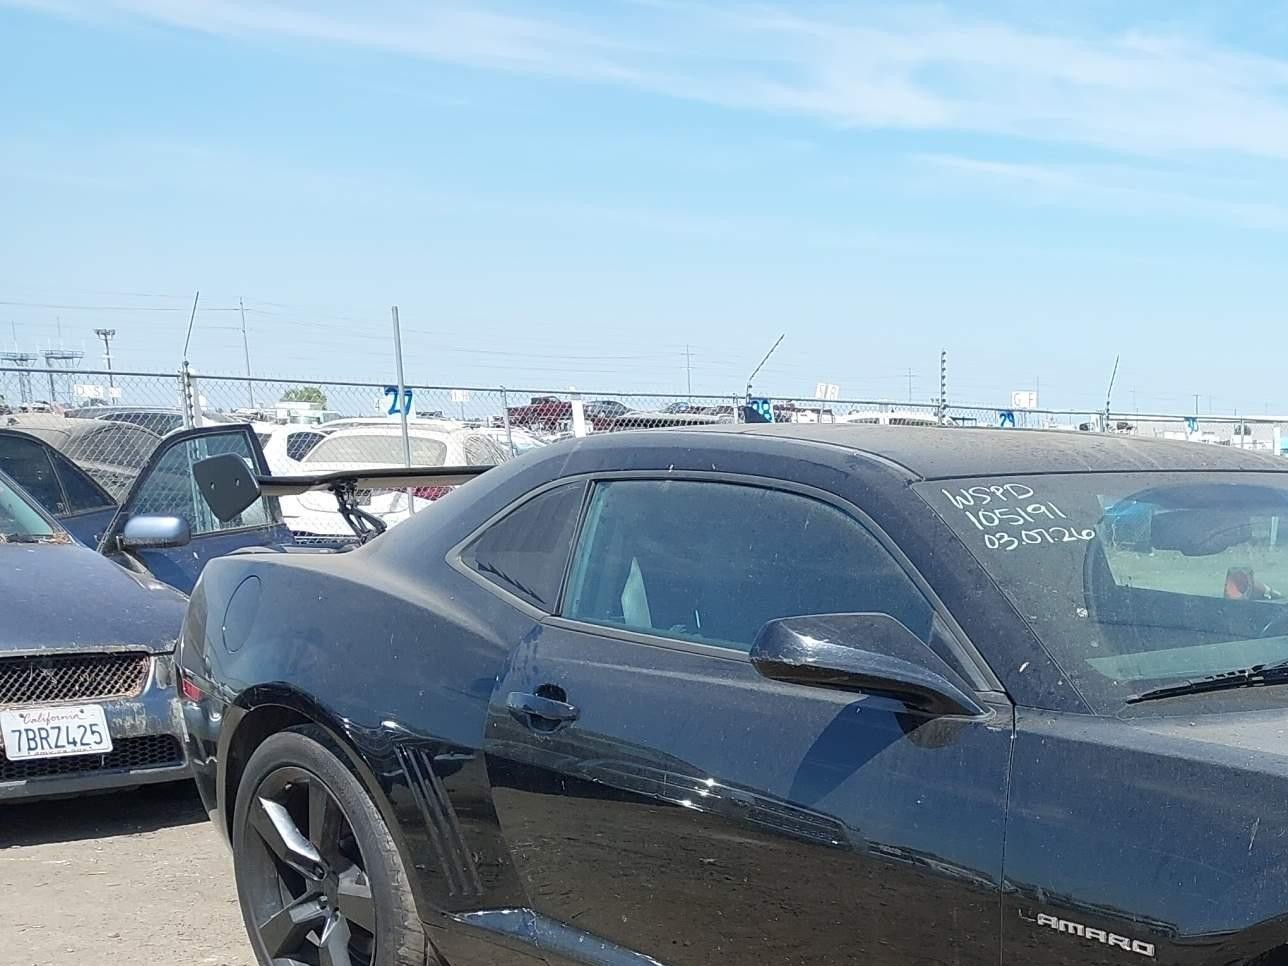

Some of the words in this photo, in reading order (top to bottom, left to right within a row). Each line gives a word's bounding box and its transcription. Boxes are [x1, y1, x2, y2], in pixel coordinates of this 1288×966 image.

[383, 385, 412, 415] 27
[942, 483, 1034, 510] WSPD
[965, 502, 1067, 530] 105191
[23, 710, 85, 726] California
[11, 723, 103, 753] 7BRZ425
